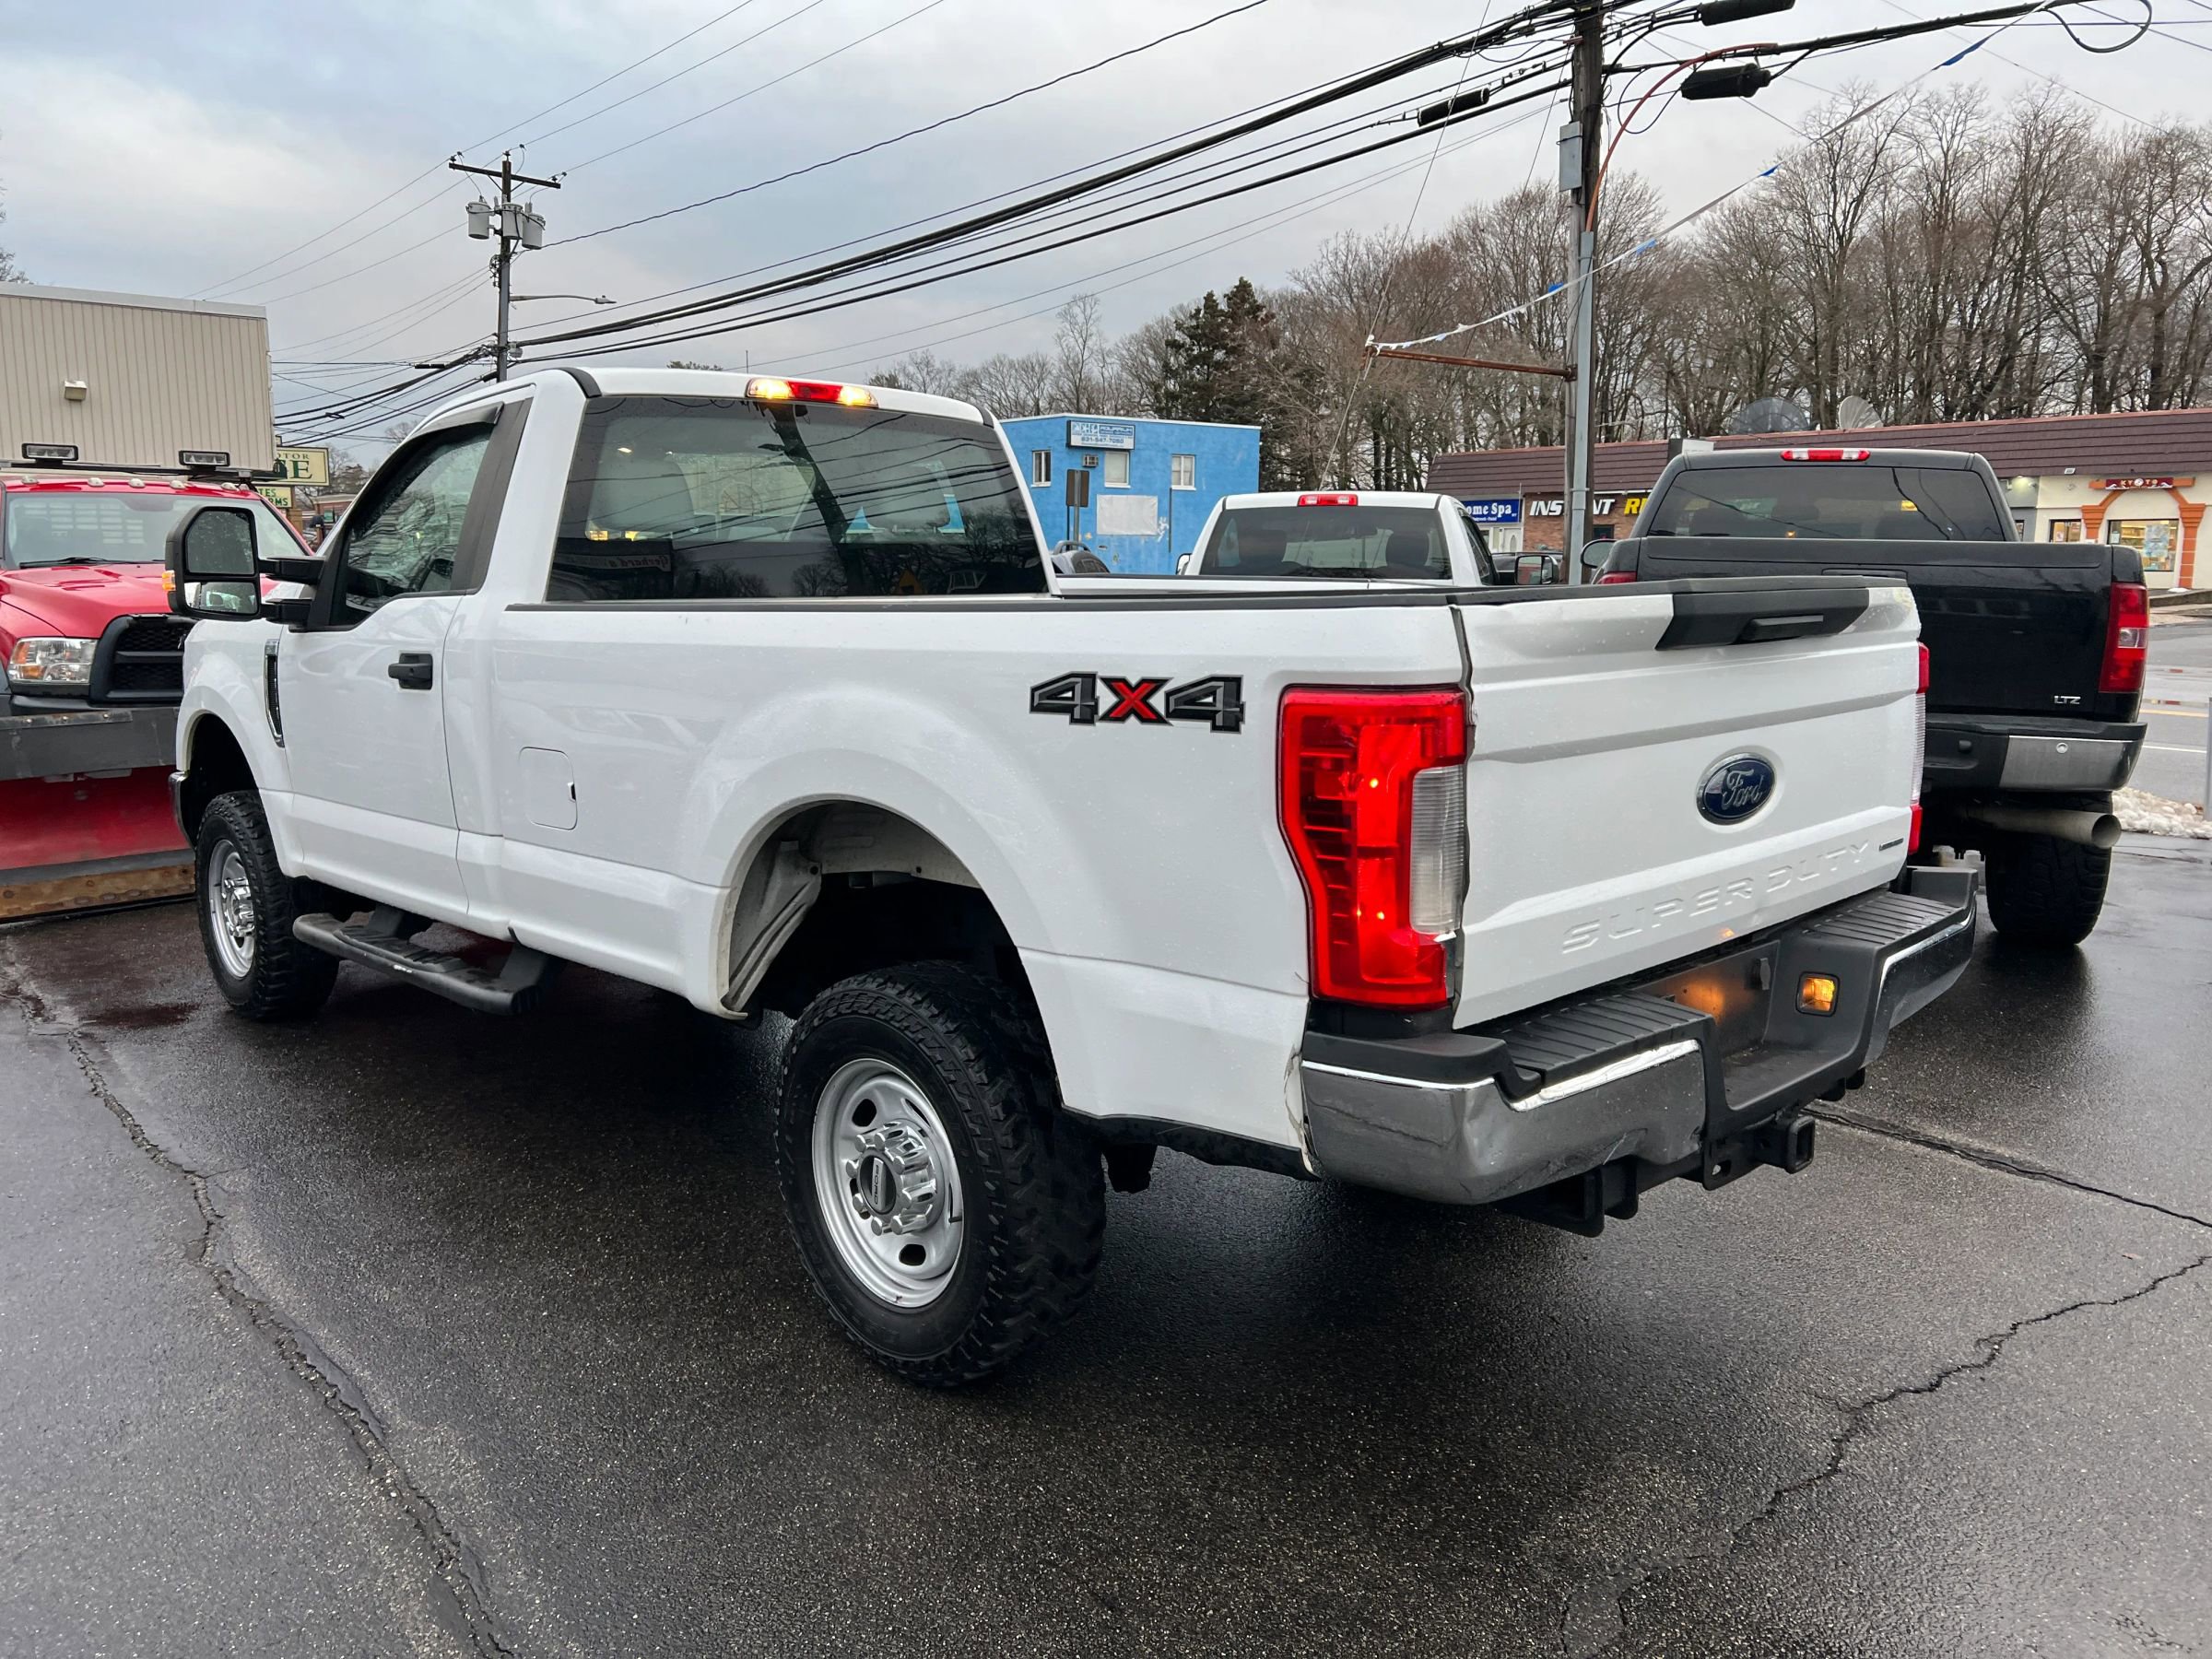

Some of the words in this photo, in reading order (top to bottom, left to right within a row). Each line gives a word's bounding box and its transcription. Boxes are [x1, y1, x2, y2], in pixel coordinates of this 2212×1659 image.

[1490, 502, 1512, 517] Spa
[1530, 499, 1615, 515] INSNT
[2053, 695, 2082, 705] LTZ
[1721, 769, 1765, 810] Ford
[1561, 877, 1754, 954] SUPER
[1766, 839, 1869, 893] DUTY
